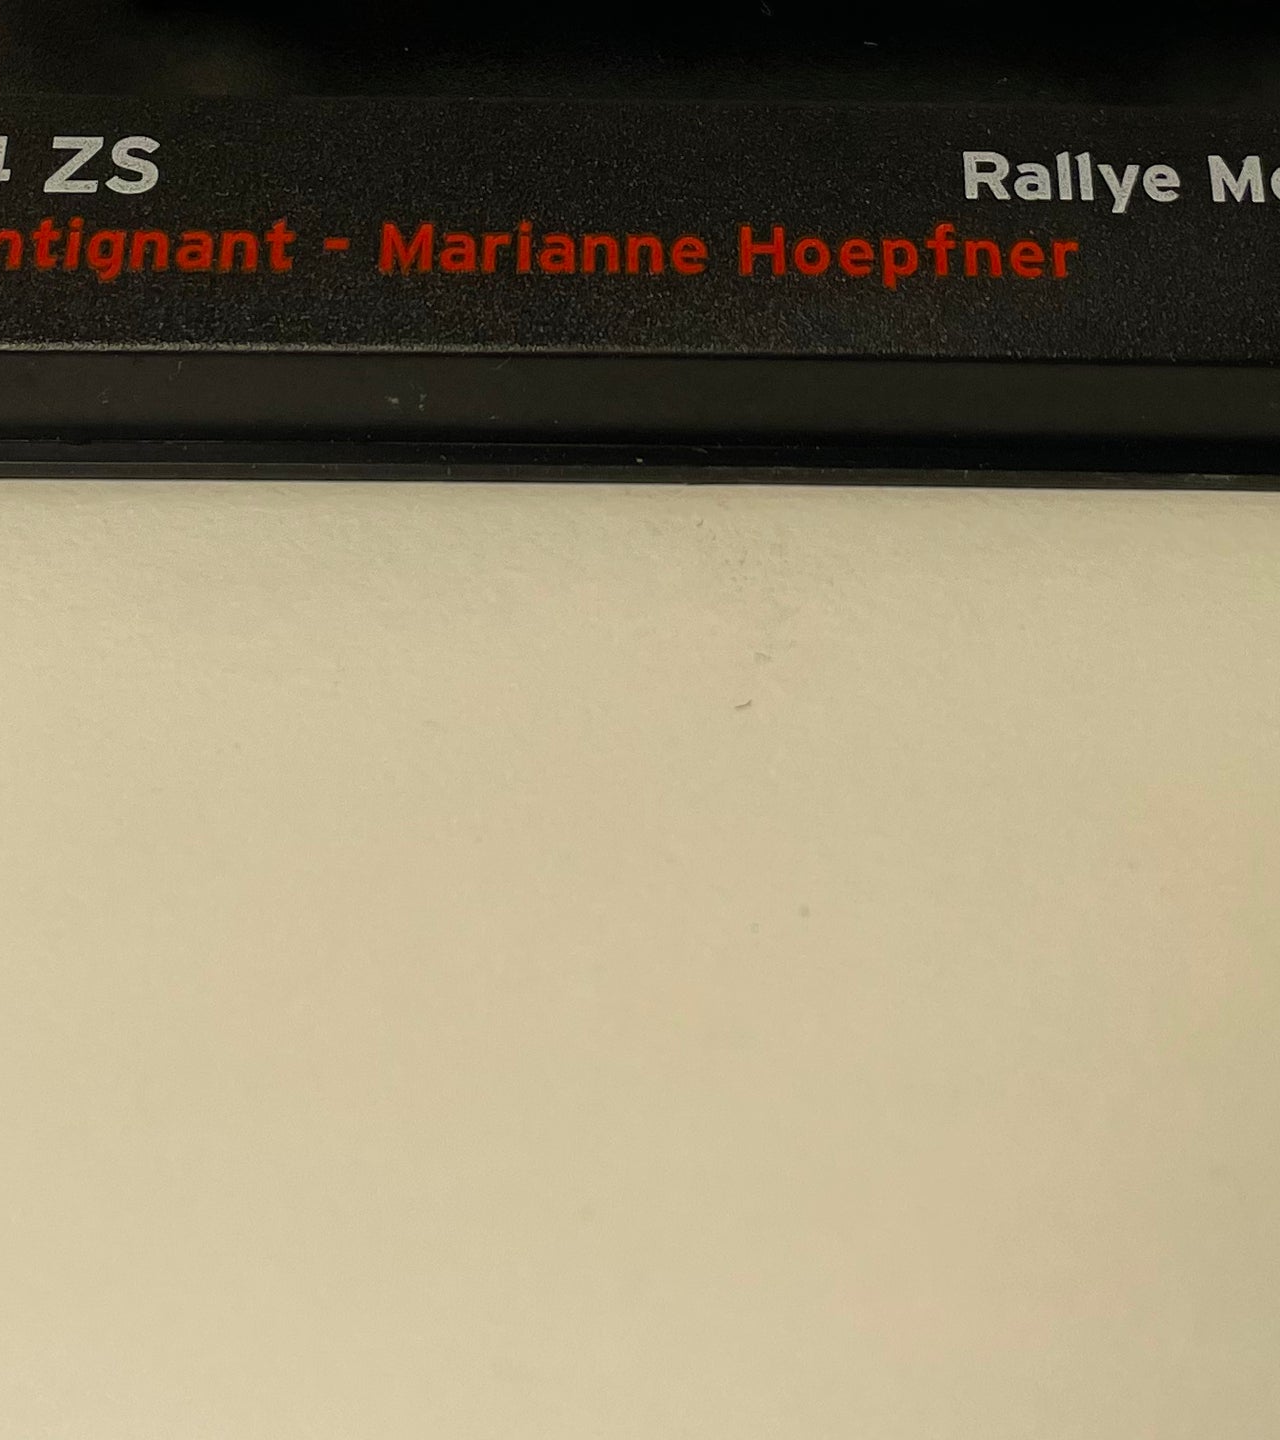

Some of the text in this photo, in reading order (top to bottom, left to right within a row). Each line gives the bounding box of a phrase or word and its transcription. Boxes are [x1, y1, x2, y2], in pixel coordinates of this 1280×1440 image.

[43, 135, 161, 195] ZS
[962, 151, 1181, 214] Rallye
[380, 221, 707, 274] Marianne
[740, 223, 1078, 288] Hoepfner
